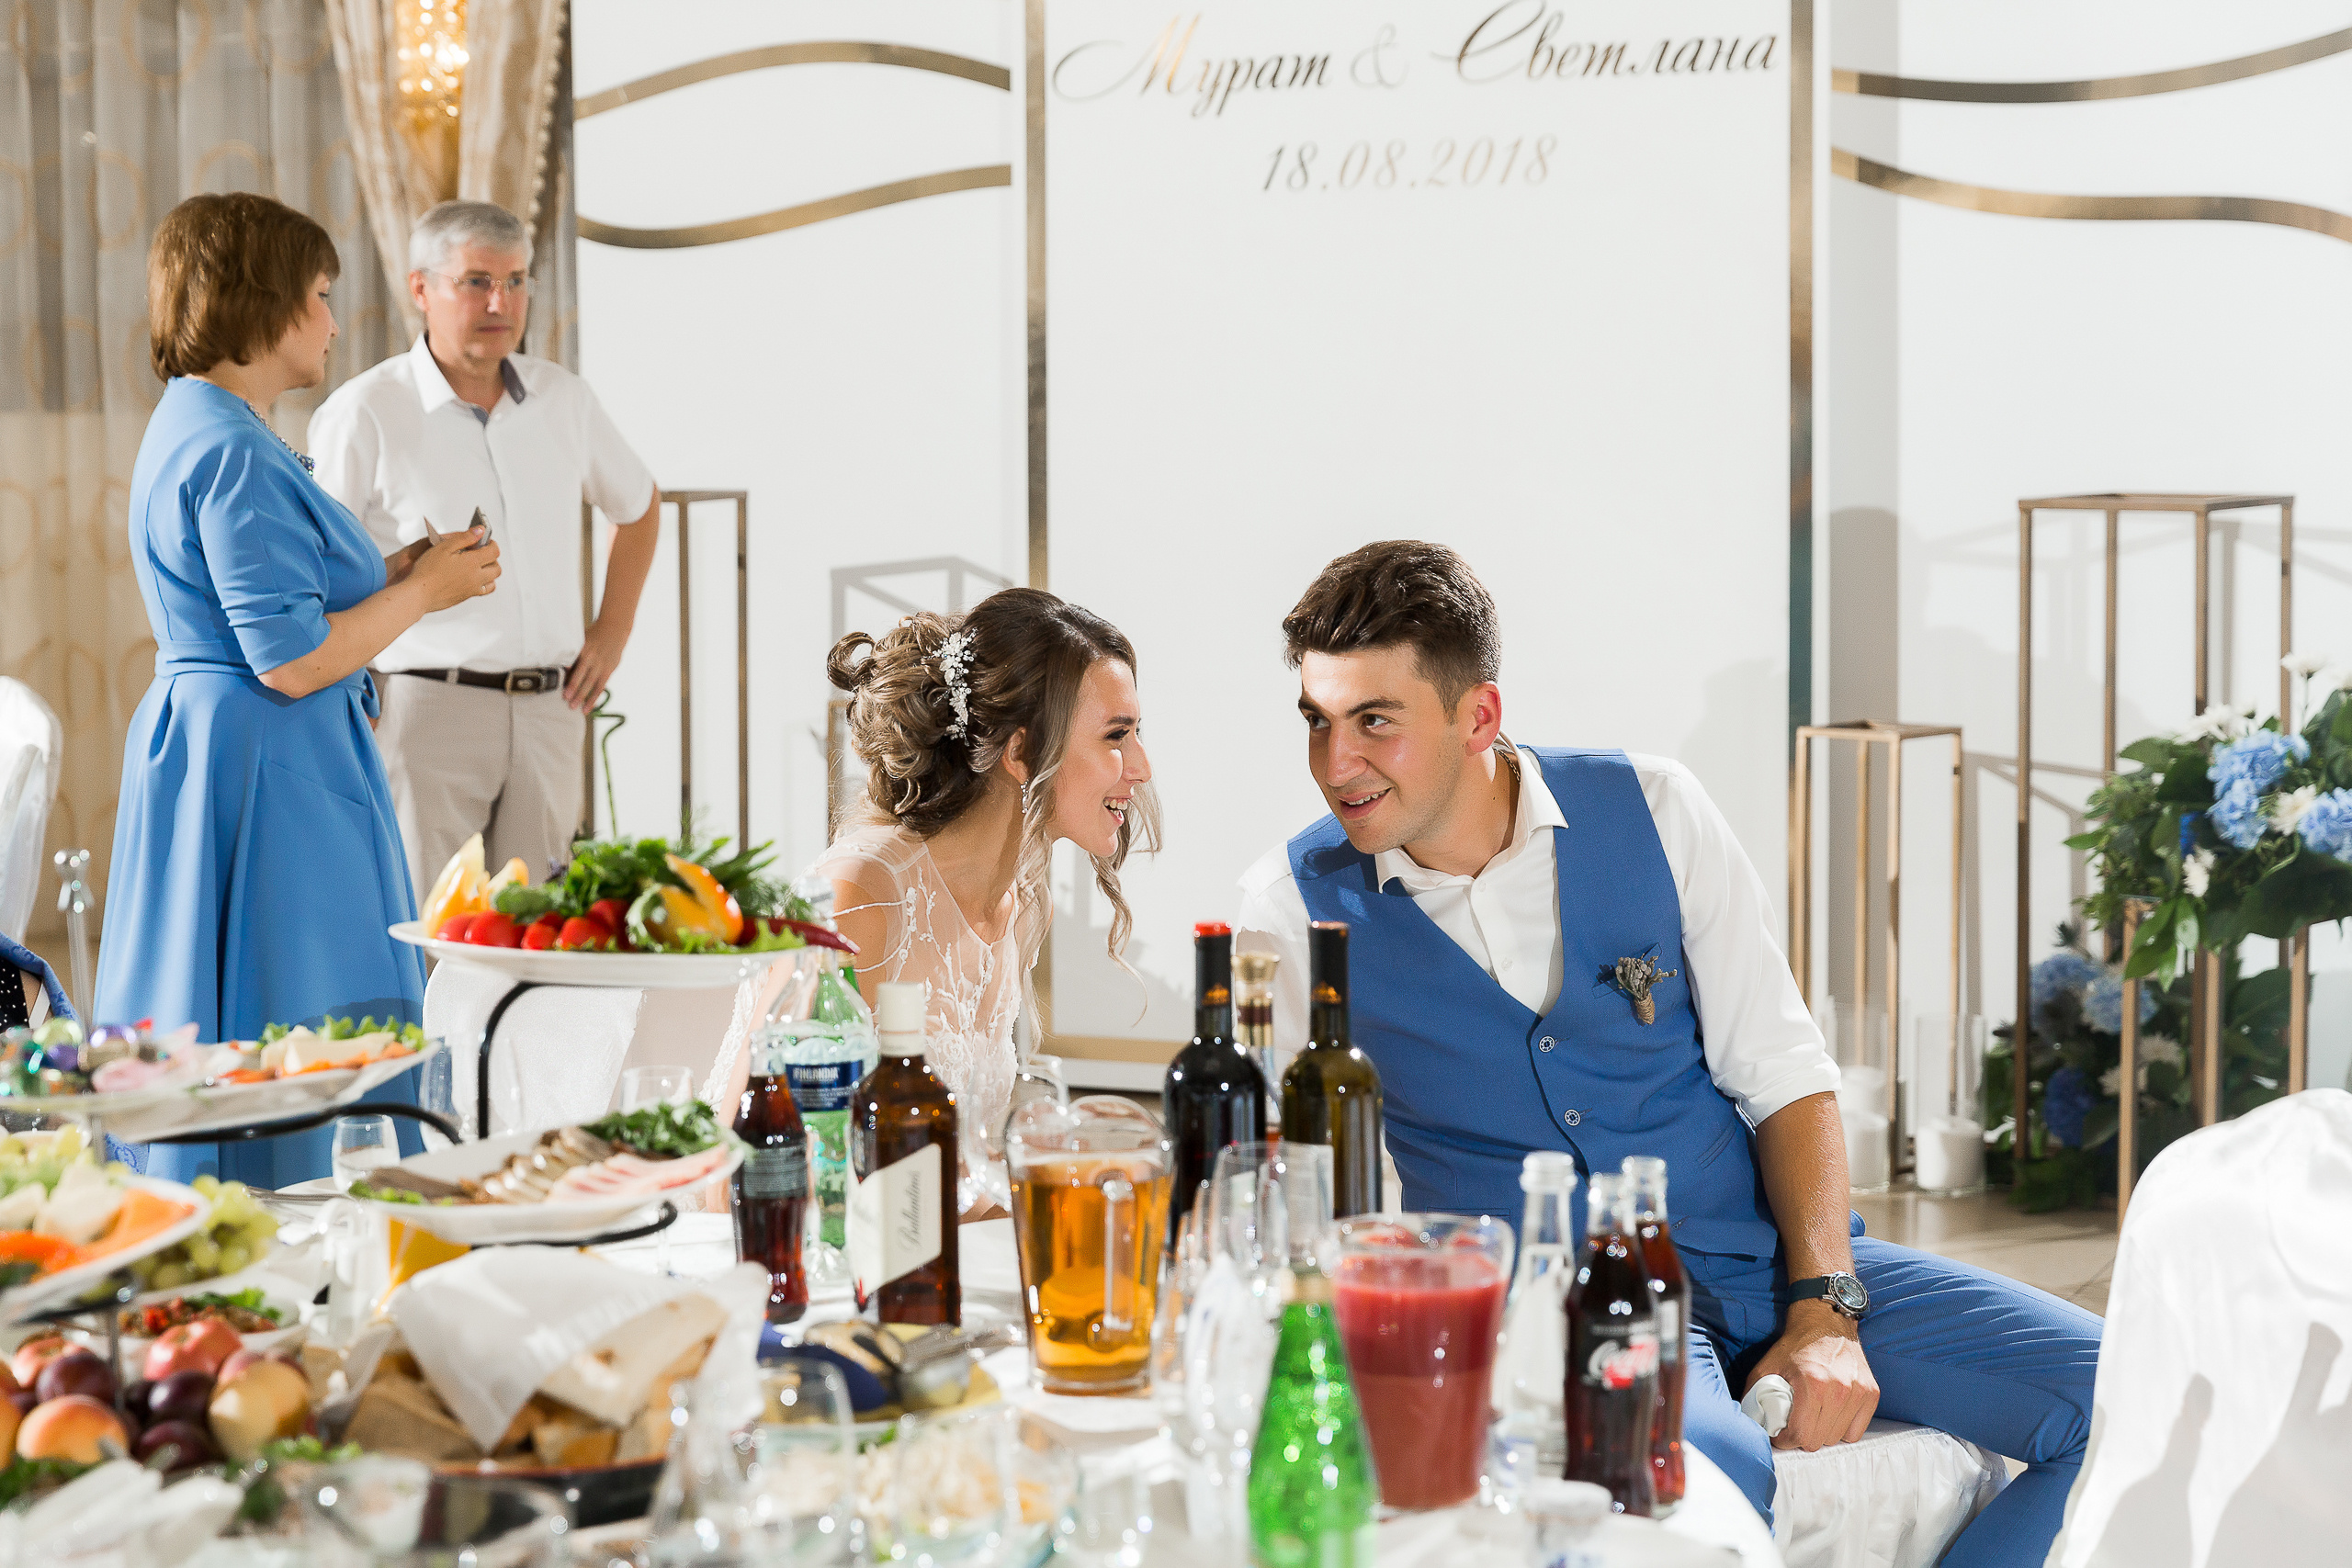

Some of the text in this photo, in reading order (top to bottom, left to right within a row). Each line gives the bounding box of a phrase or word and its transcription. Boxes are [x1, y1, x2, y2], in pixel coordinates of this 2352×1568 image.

[1051, 0, 1781, 119] Мурат & Светлана
[1261, 131, 1560, 194] 18.08.2018
